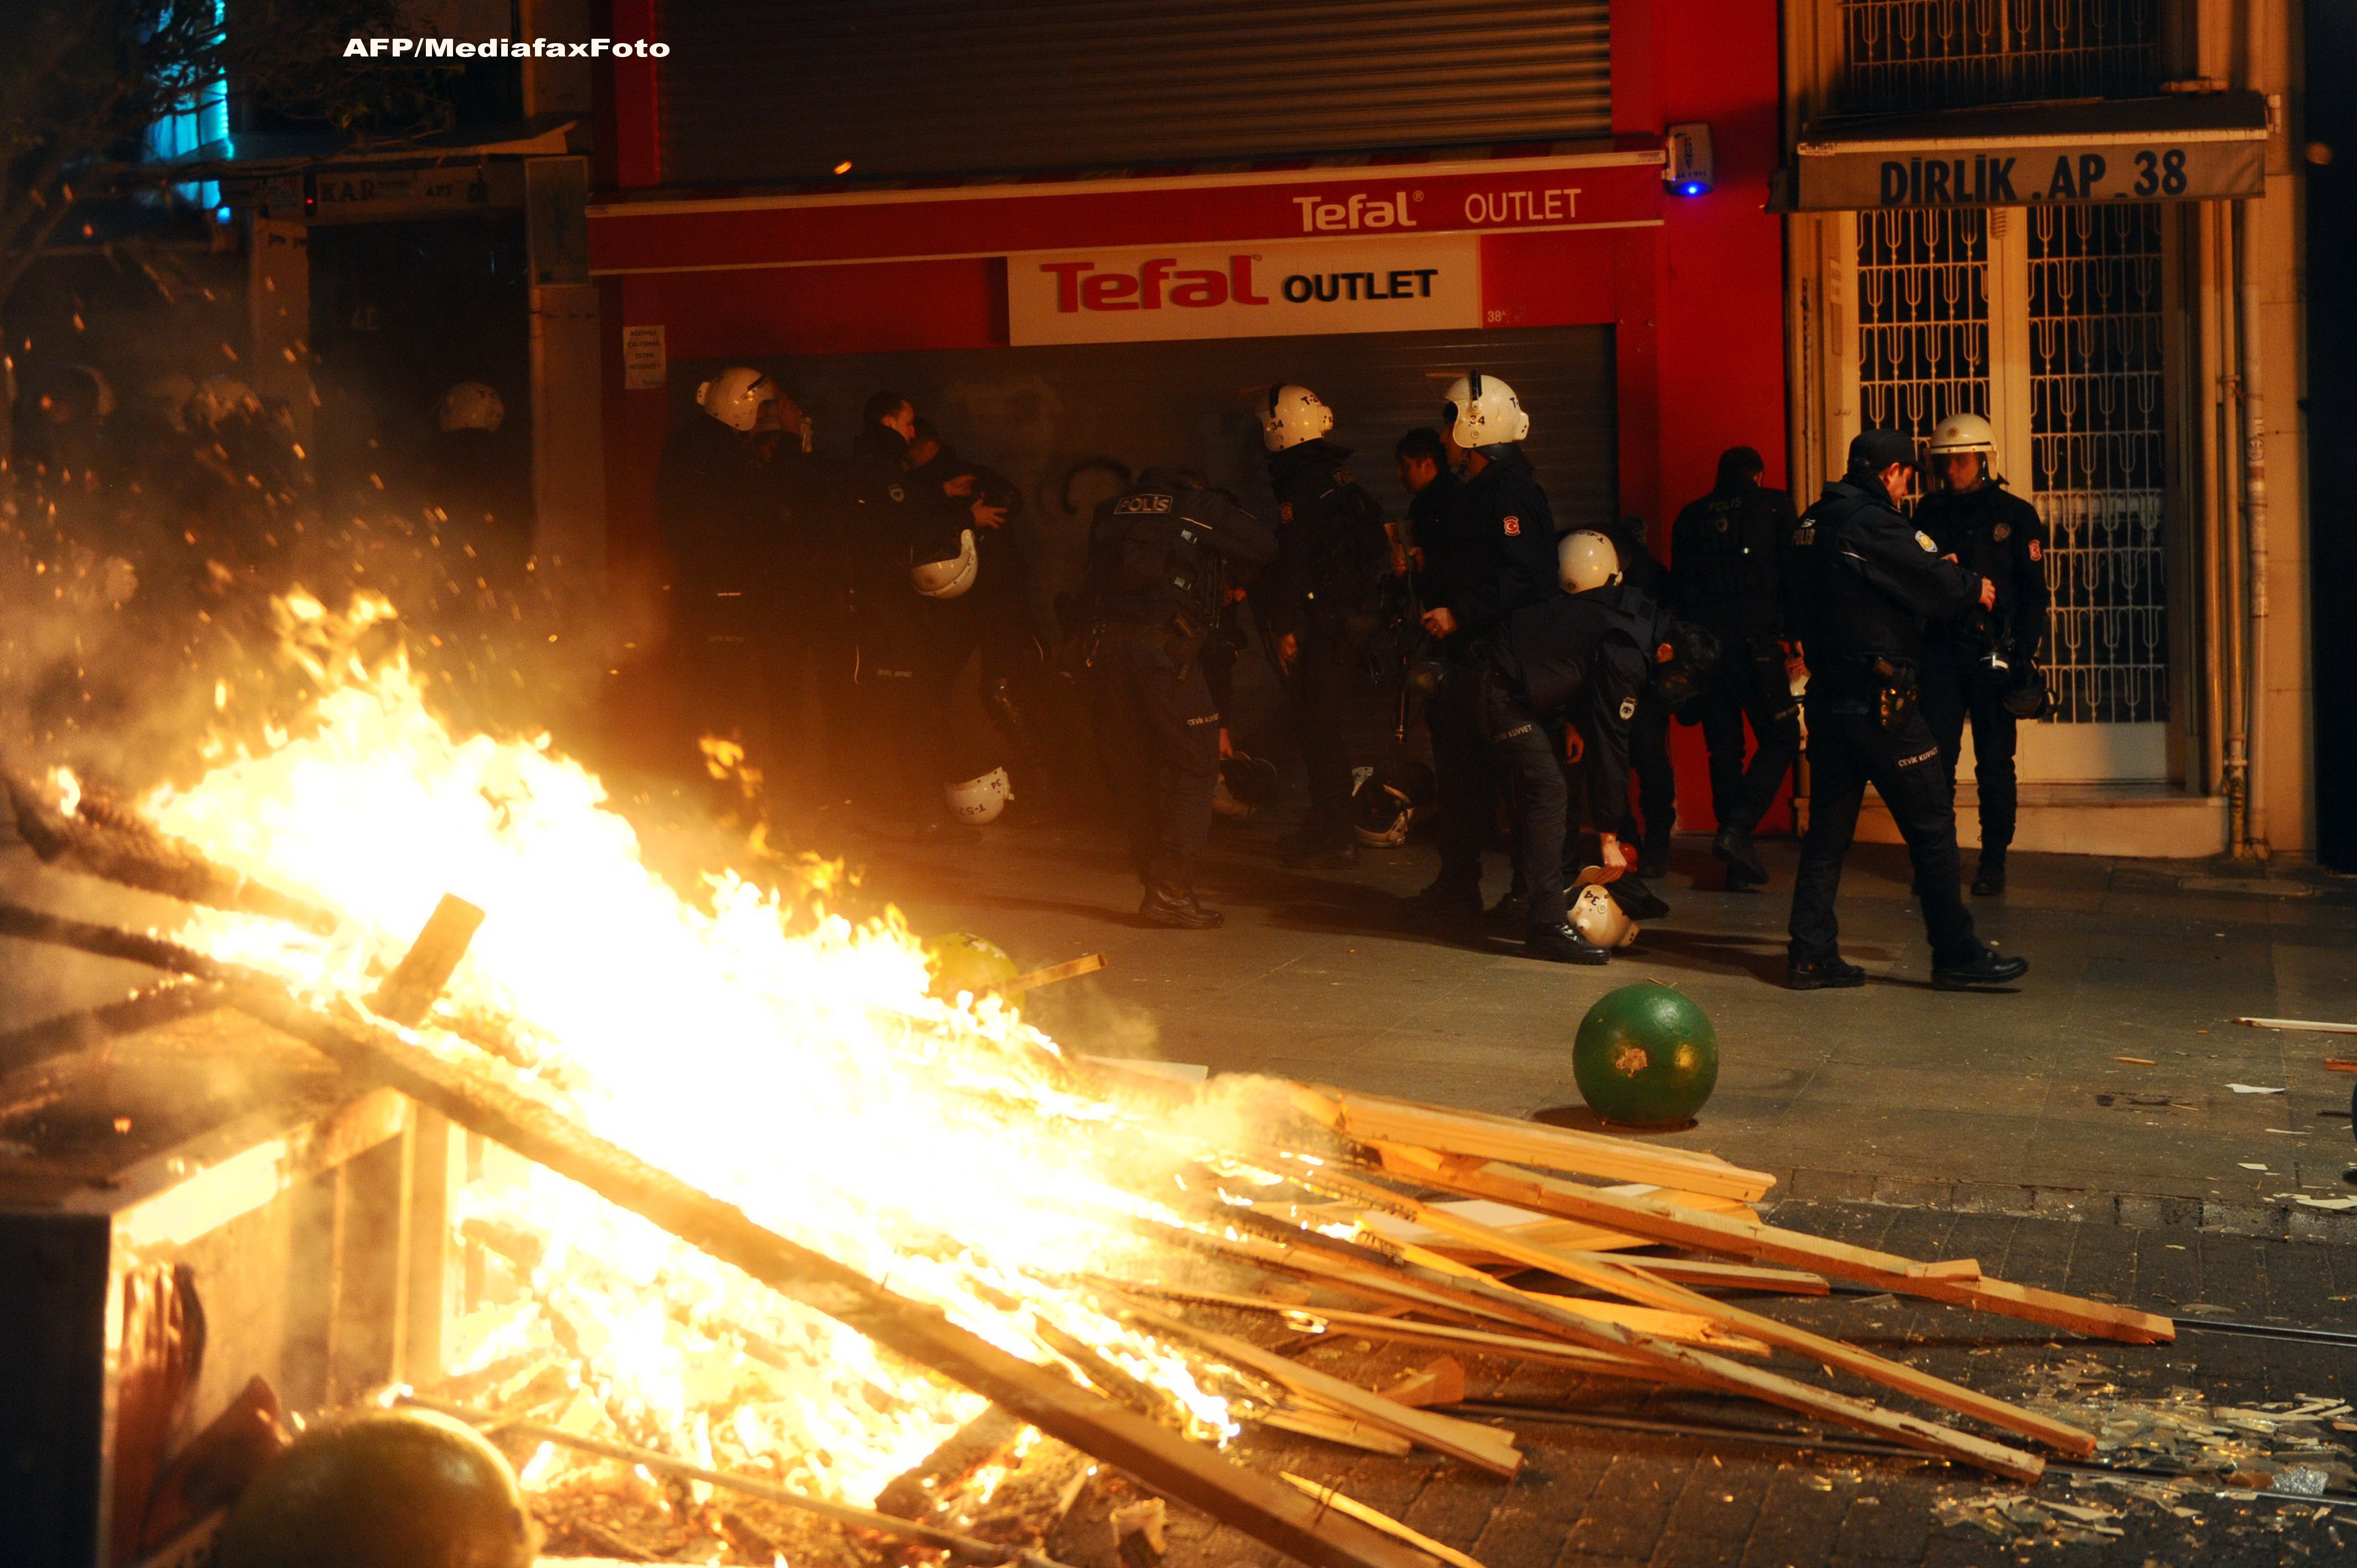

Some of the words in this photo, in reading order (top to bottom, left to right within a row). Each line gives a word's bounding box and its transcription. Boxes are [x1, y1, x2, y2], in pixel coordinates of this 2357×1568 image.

[1881, 154, 2018, 205] DİRLİK
[1464, 188, 1582, 223] OUTLET
[1282, 269, 1438, 305] OUTLET
[1270, 419, 1284, 431] 34
[1469, 415, 1485, 425] 34
[1584, 890, 1600, 906] 34
